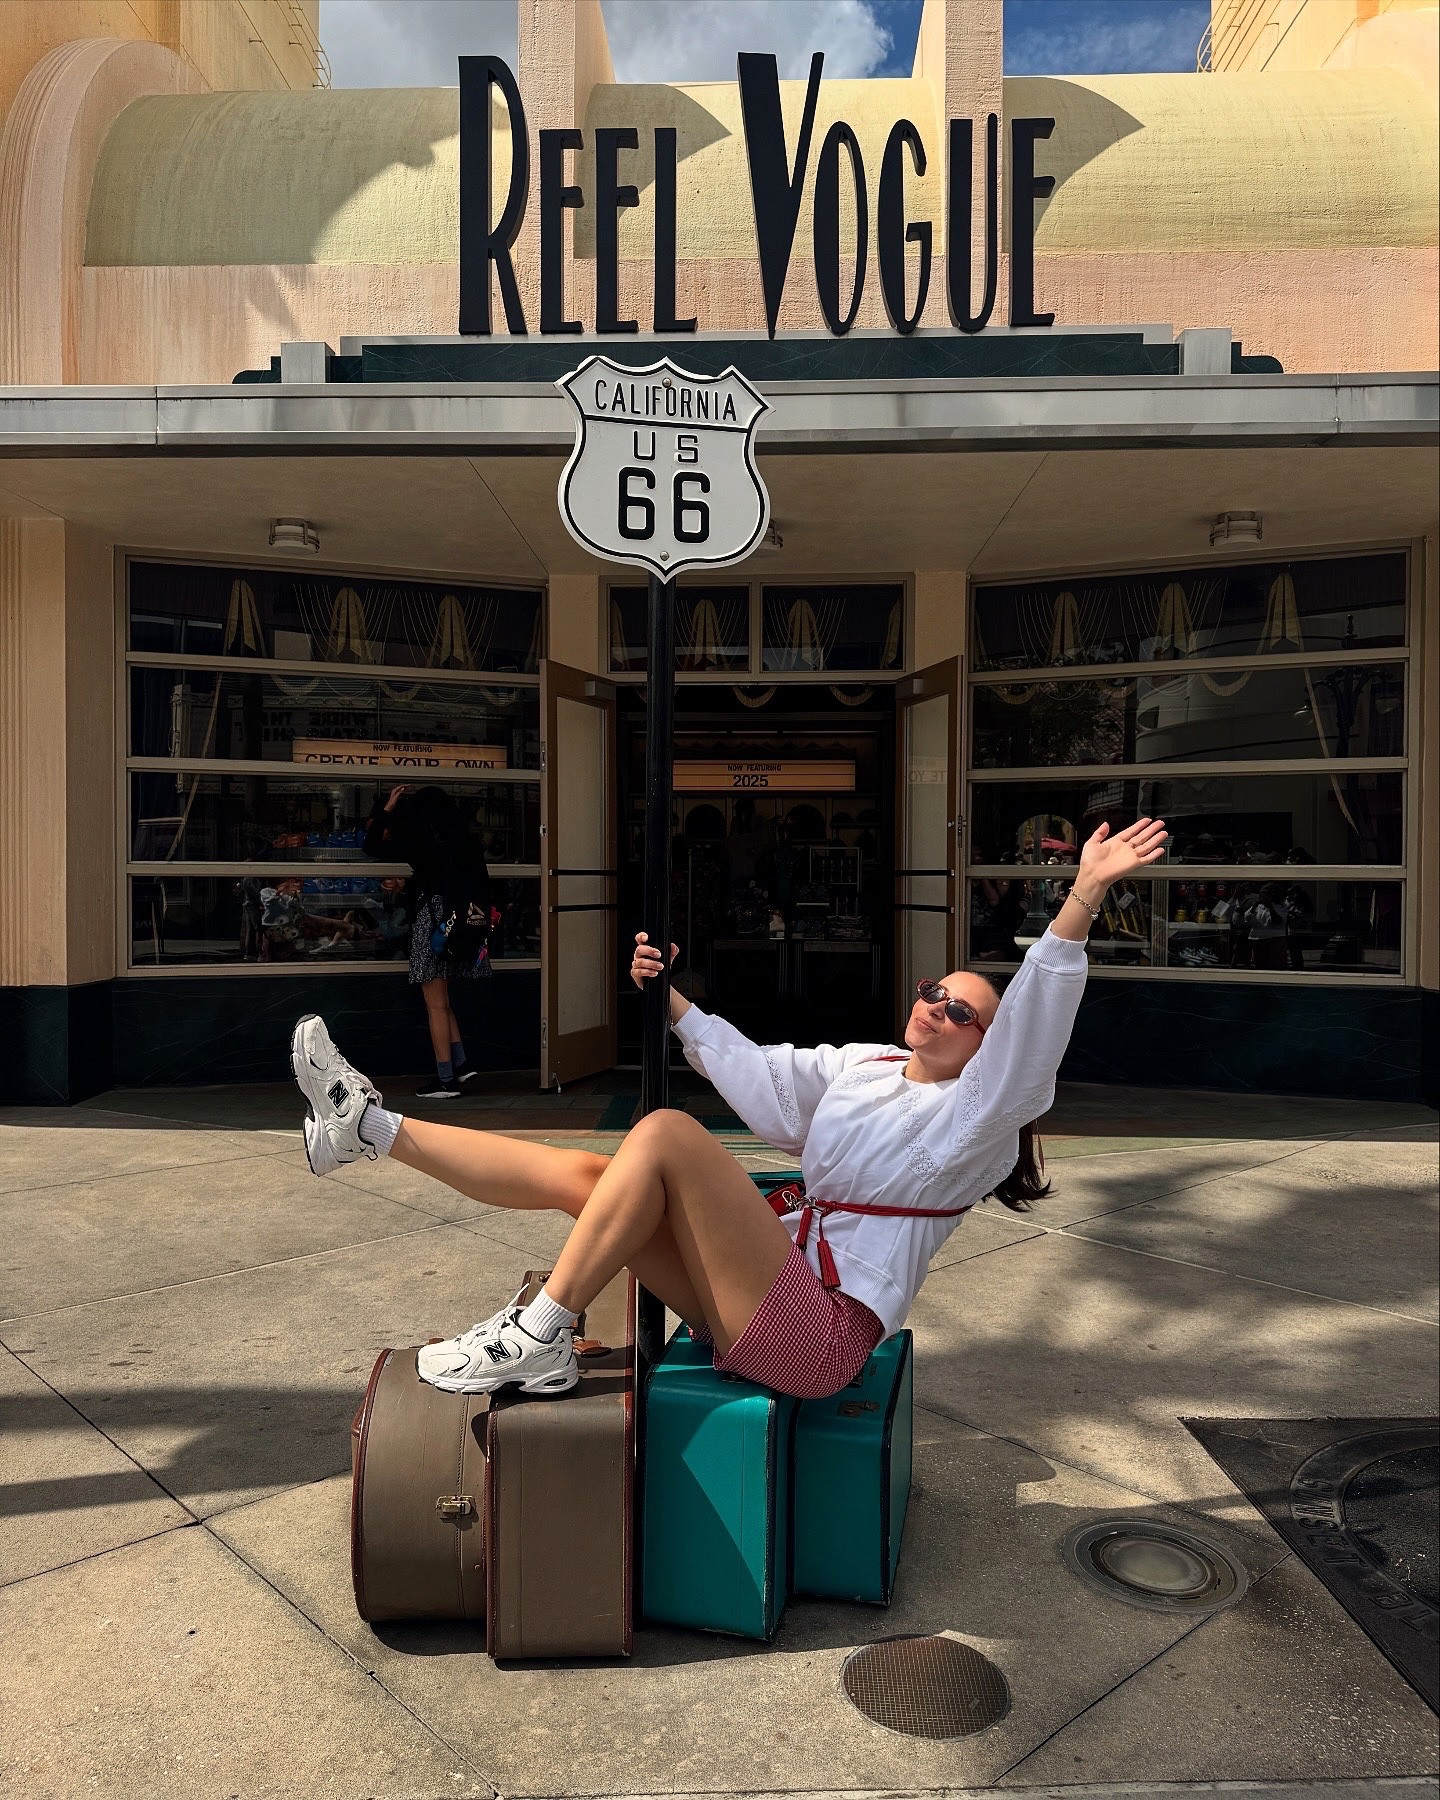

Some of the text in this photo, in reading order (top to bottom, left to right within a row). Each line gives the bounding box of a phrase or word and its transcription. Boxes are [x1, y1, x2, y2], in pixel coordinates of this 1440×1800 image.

[458, 52, 1055, 341] REEL VOGUE
[594, 378, 737, 423] CALIFORNIA
[617, 467, 711, 543] 66
[373, 744, 433, 753] NOW FEATURING
[727, 764, 782, 772] NOW FEATURING
[732, 774, 769, 788] 2025
[327, 1079, 349, 1109] N
[483, 1341, 512, 1364] N
